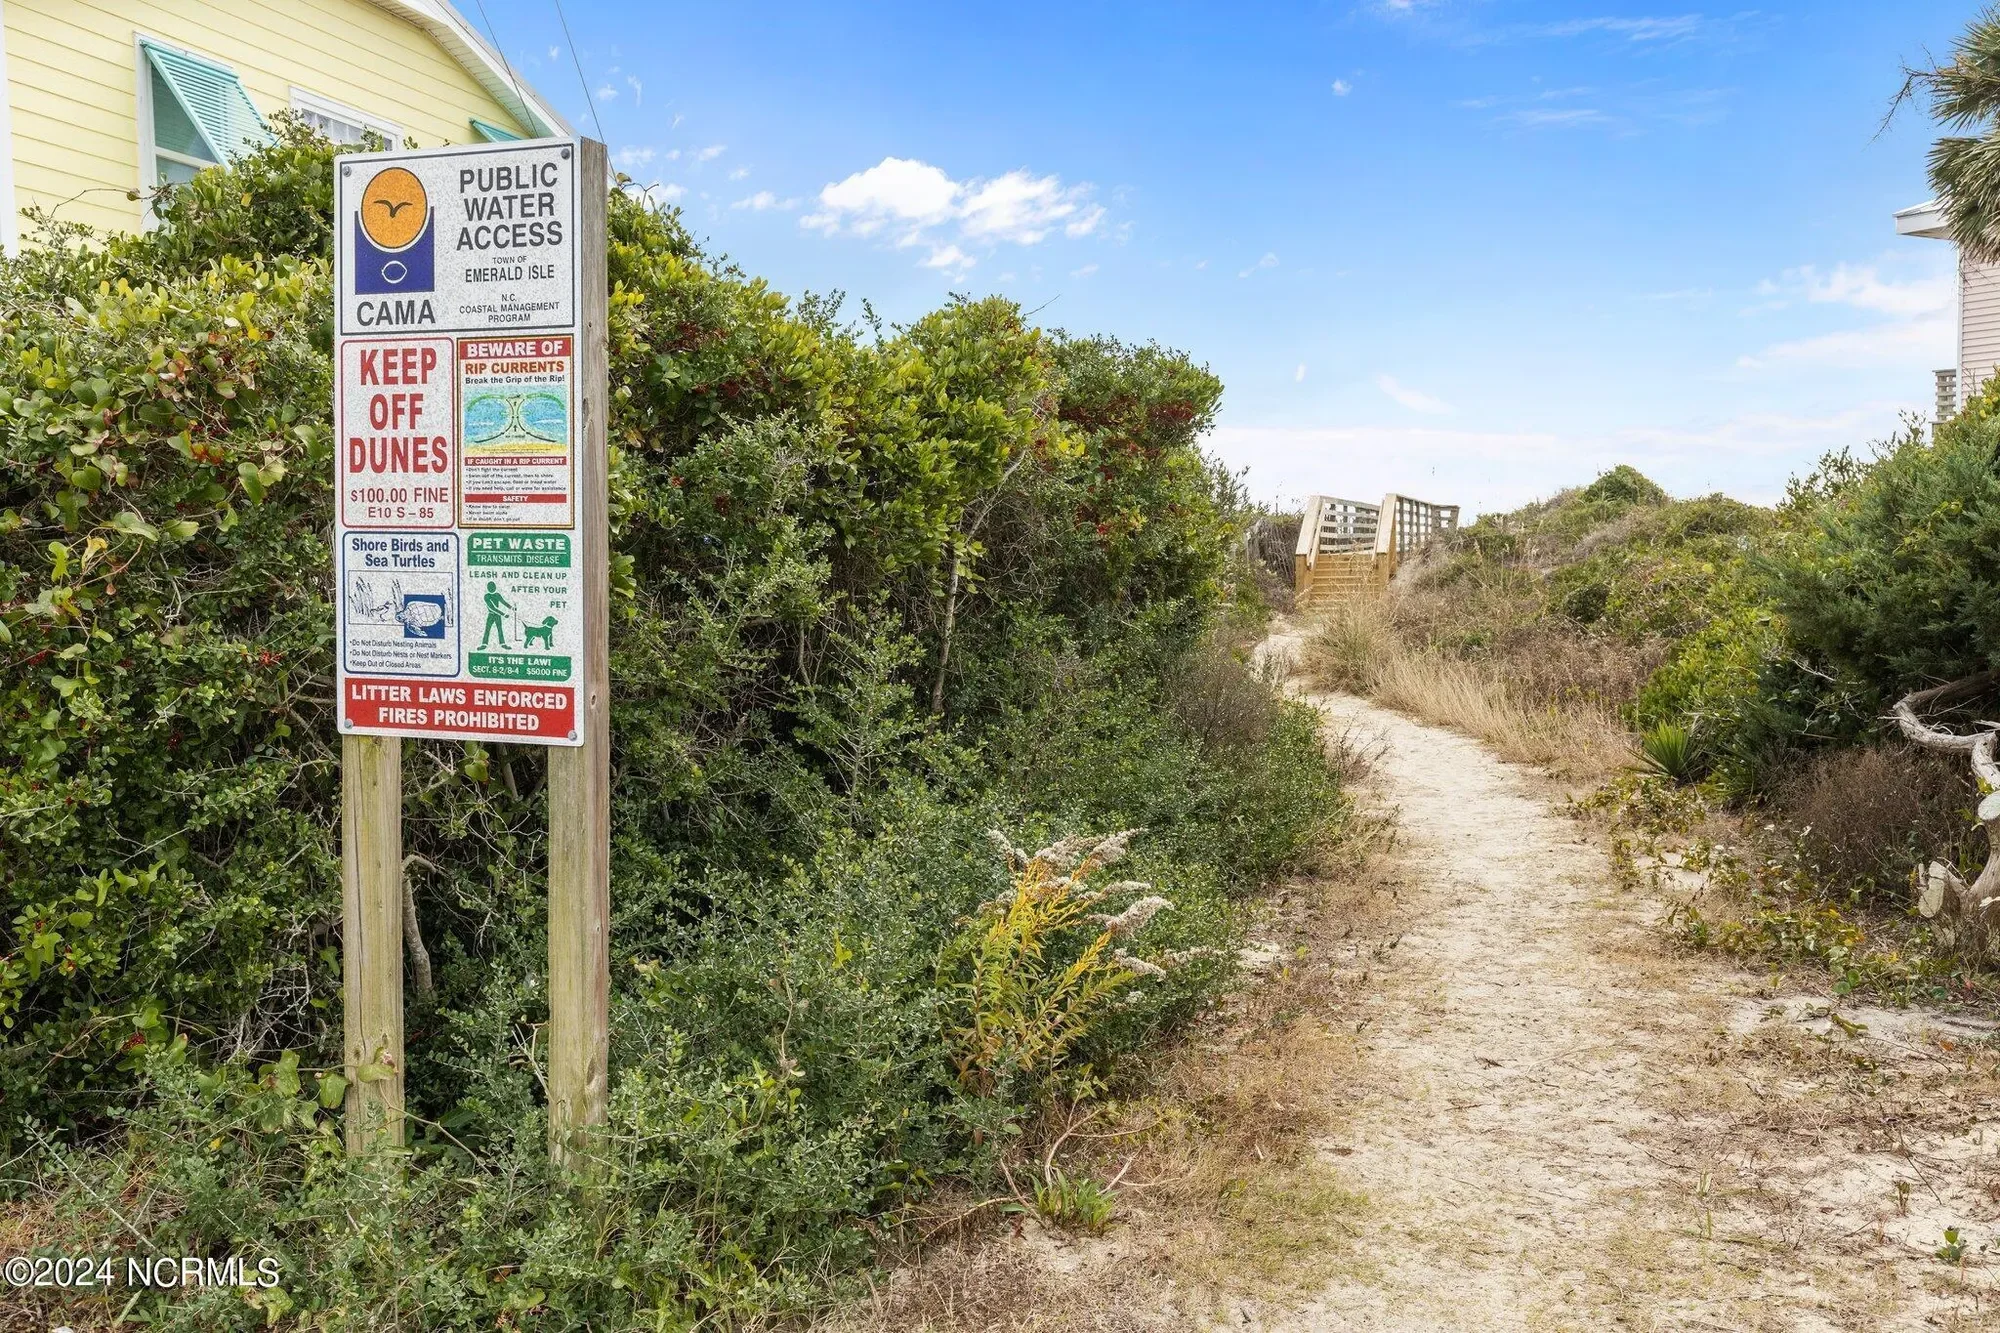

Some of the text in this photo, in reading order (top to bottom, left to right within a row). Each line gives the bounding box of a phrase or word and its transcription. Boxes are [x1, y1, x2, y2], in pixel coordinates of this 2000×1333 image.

[460, 162, 558, 193] PUBLIC
[464, 193, 554, 221] WATER
[457, 221, 563, 251] ACCESS
[465, 265, 554, 283] EMERALD ISLE
[502, 293, 516, 302] N.C.
[357, 300, 435, 326] CAMA
[460, 302, 560, 314] COASTAL MANAGEMENT
[488, 313, 530, 323] PROGRAM
[467, 341, 563, 358] BEWARE OF
[360, 348, 437, 386] KEEP
[466, 361, 564, 374] RIP CURRENTS
[506, 376, 522, 384] Grip
[370, 393, 423, 430] OFF
[350, 436, 448, 473] DUNES
[351, 488, 448, 503] $100.00 FINE
[369, 507, 391, 518] E10
[352, 538, 449, 552] Shore Birds and
[473, 538, 565, 550] PET WASTE
[366, 554, 435, 567] Sea Turtles
[476, 555, 559, 564] TRANSMITS DISEASE
[393, 641, 413, 649] Nesting
[528, 658, 551, 666] LAW!
[352, 684, 567, 710] LITTER LAWS ENFORCED
[378, 707, 539, 731] FIRES PROHIBITED
